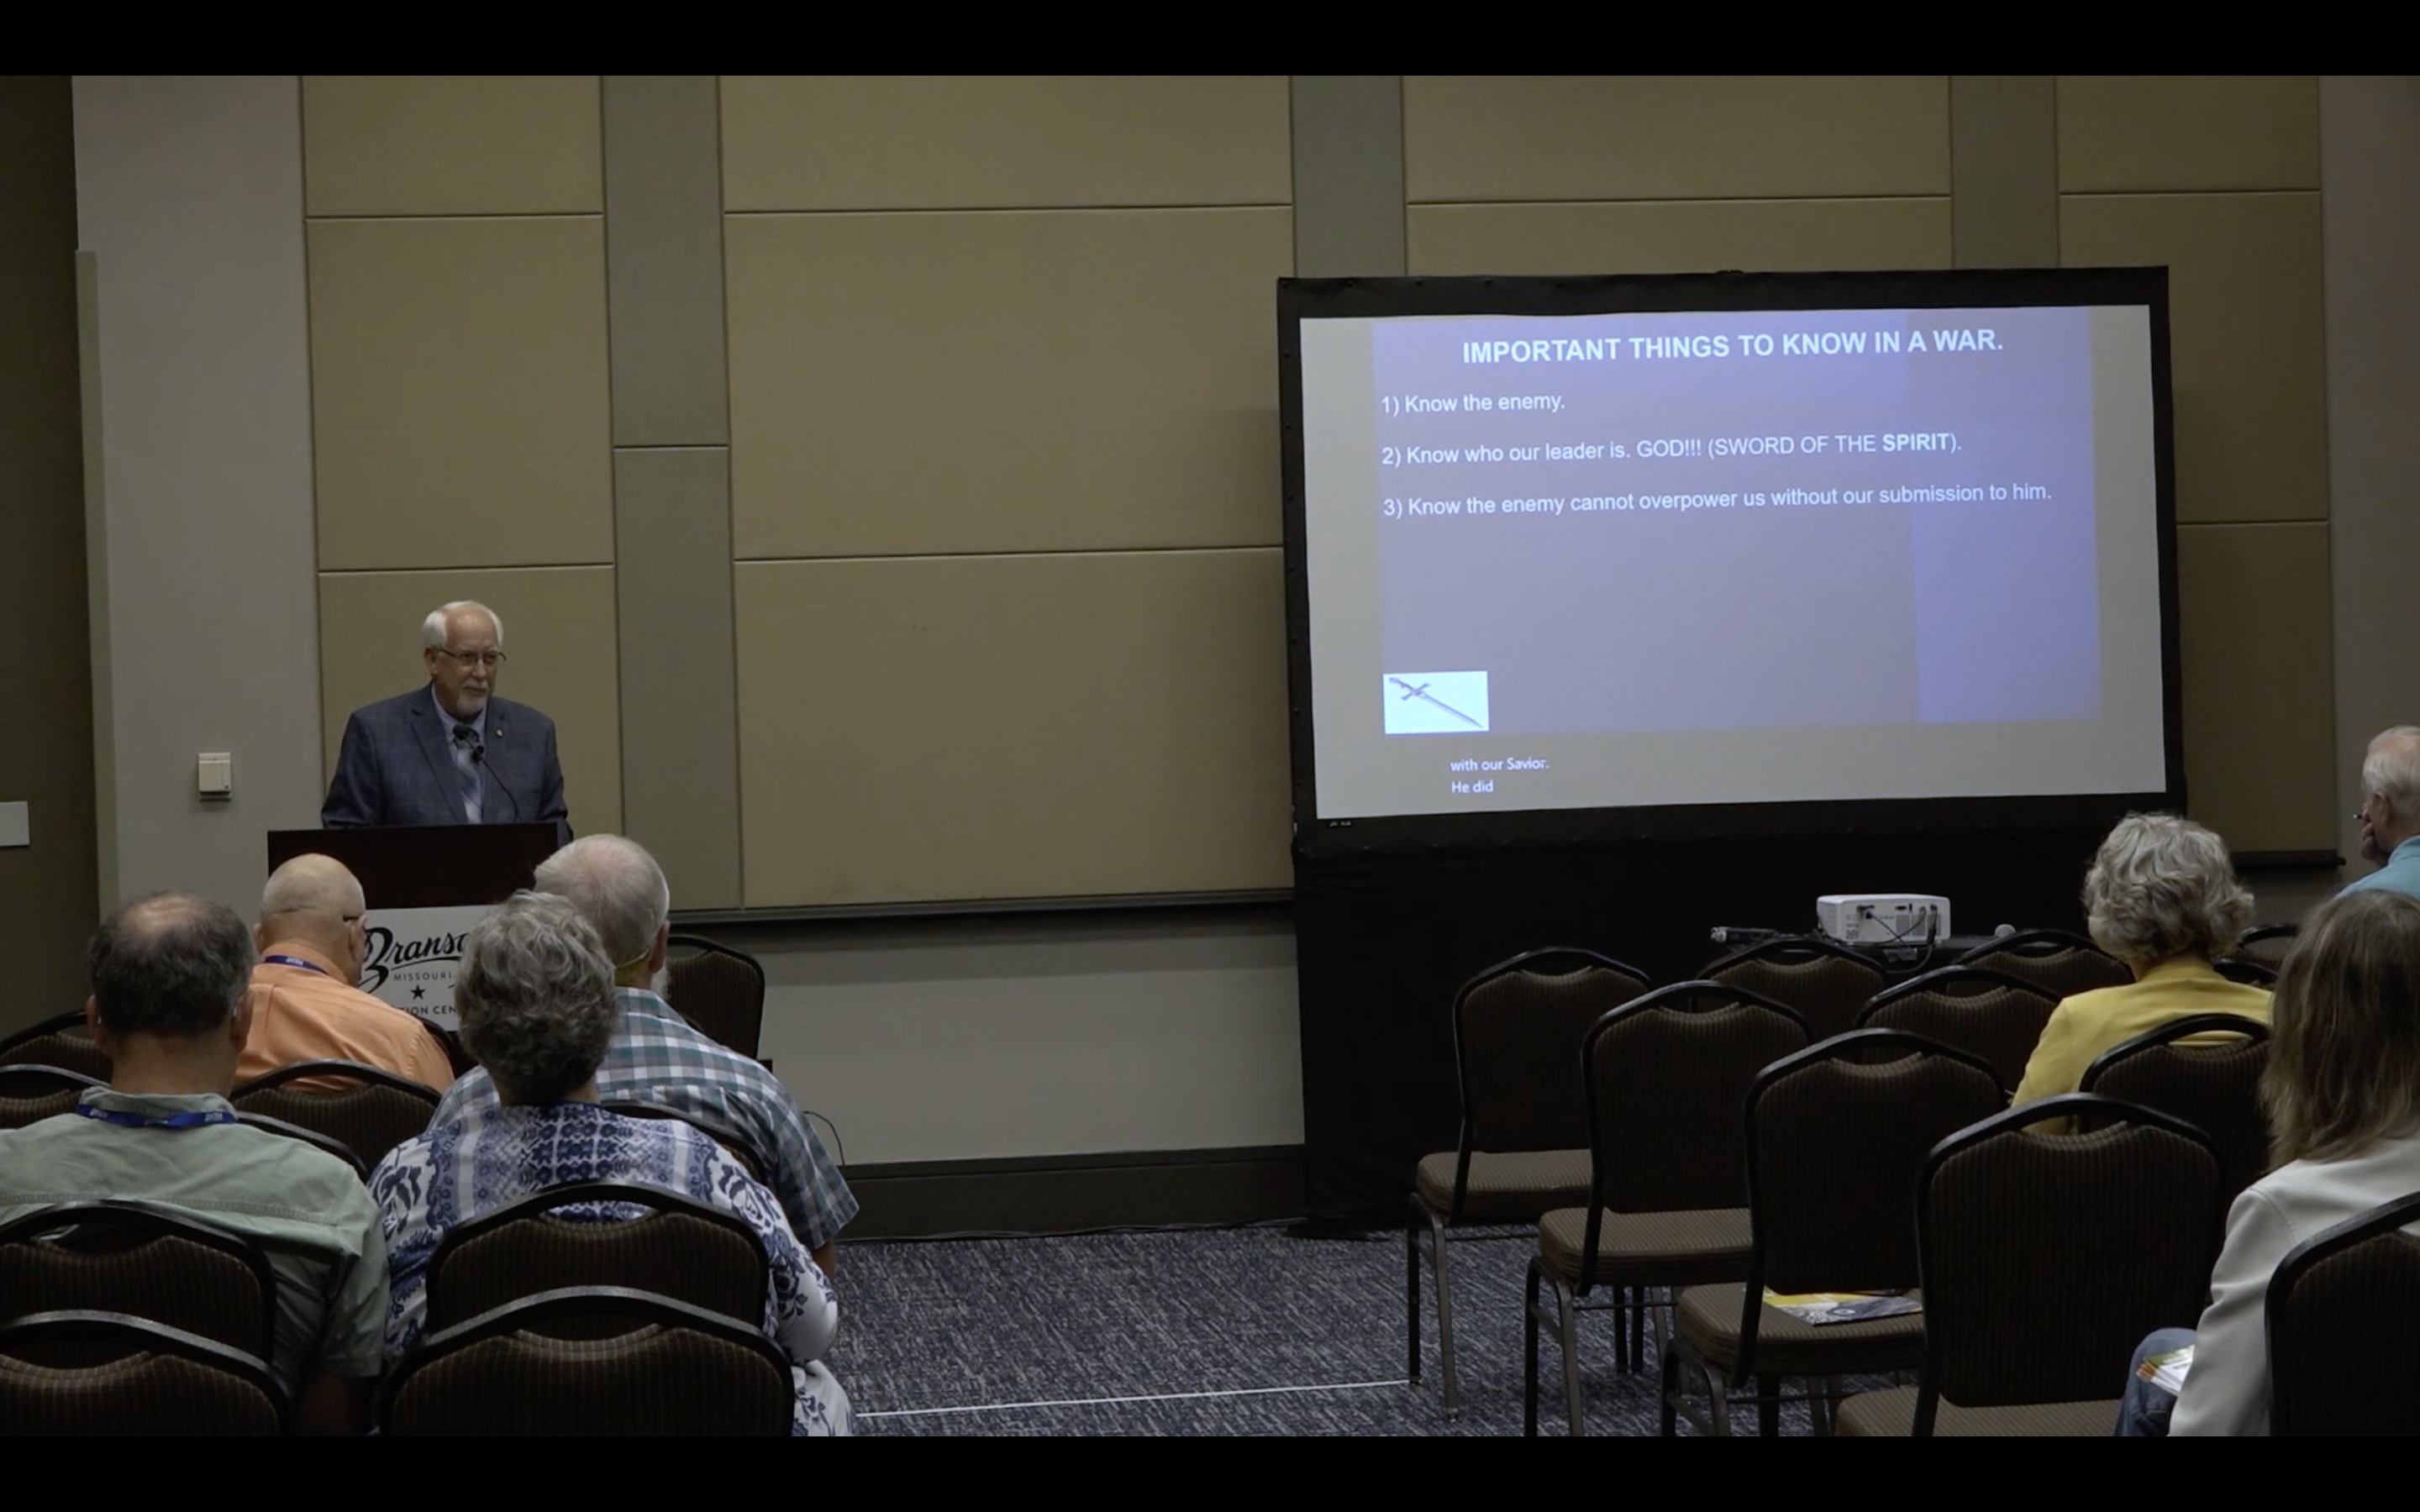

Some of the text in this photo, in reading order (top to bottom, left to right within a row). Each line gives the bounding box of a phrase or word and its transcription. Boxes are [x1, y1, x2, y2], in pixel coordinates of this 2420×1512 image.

[1463, 328, 2004, 364] IMPORTANT THINGS TO KNOW IN A WAR.
[1381, 393, 1565, 417] 1) Know the enemy.
[1381, 432, 1962, 469] 2) Know who our leader is. GOD!!! (SWORD OF THE SPIRIT).
[1383, 482, 2052, 520] 3) Know the enemy cannot overpower us without our submission to him.
[1449, 758, 1479, 772] with
[1481, 760, 1504, 771] our
[1451, 779, 1494, 794] He did
[393, 971, 452, 982] MISSOURI
